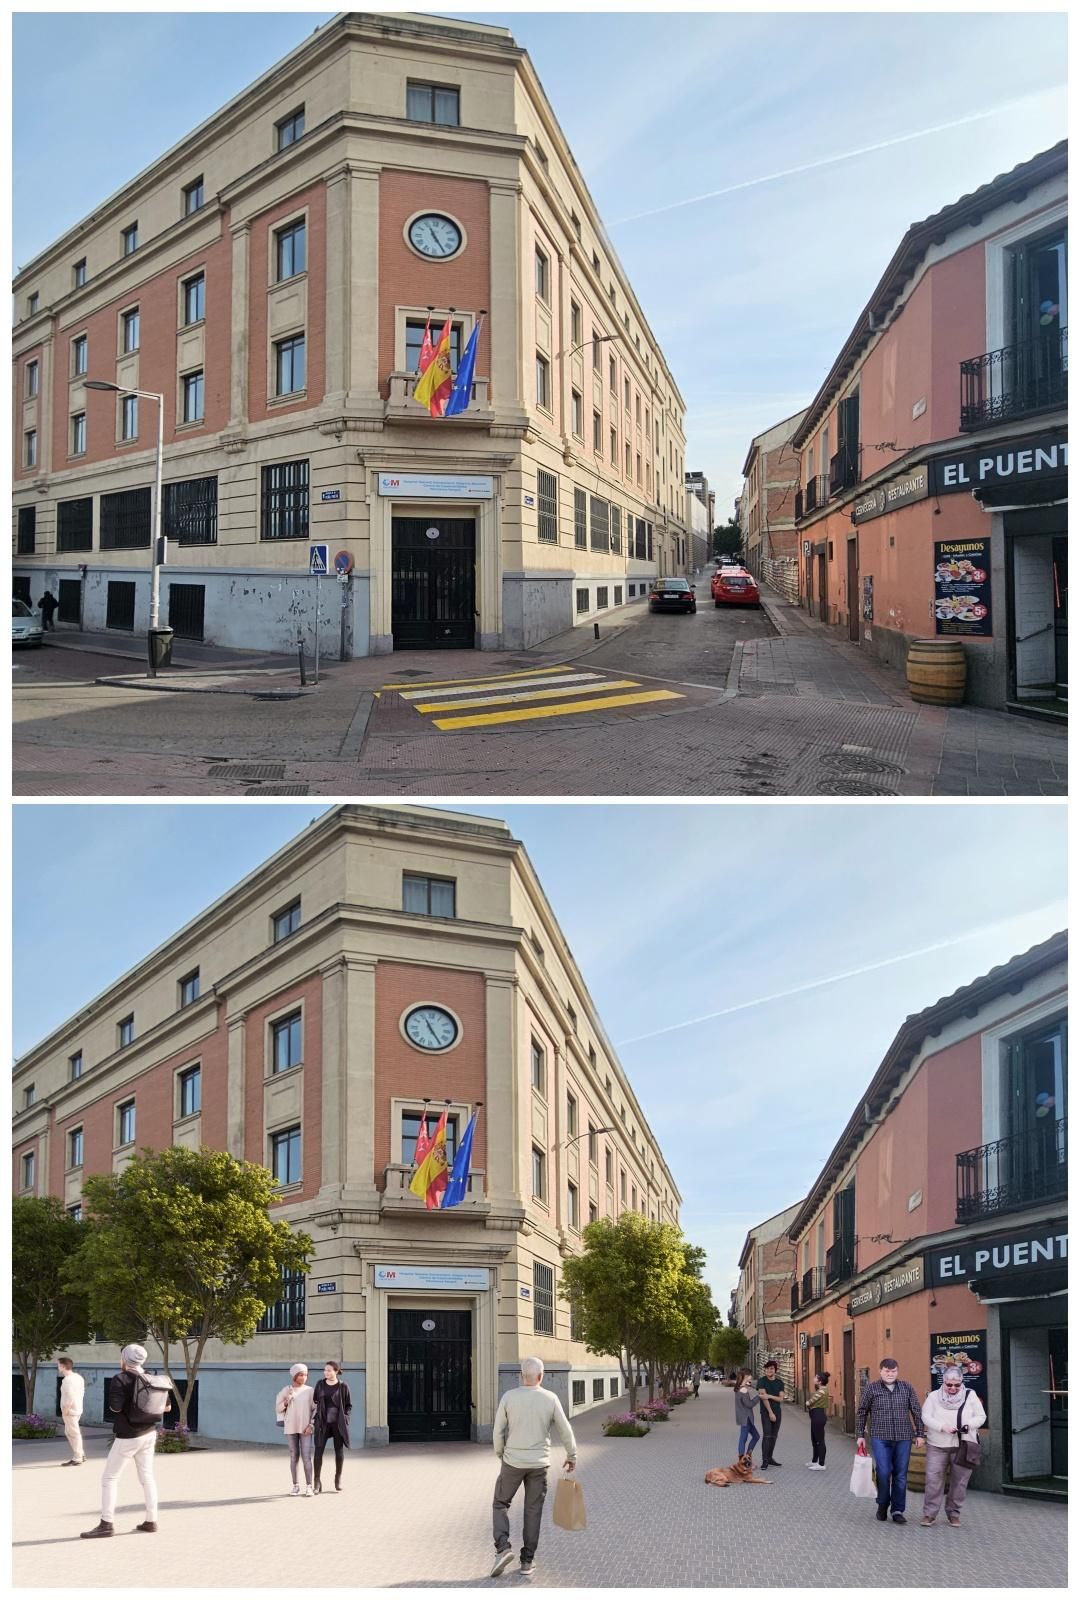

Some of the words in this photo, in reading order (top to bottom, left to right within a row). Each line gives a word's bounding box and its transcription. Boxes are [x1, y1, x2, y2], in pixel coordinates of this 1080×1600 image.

[943, 464, 970, 486] EL
[887, 475, 924, 501] RESTAURANTE
[940, 542, 985, 554] Desayunos
[939, 1255, 966, 1278] EL
[883, 1267, 920, 1293] RESTAURANTE
[936, 1334, 981, 1345] Desayunos
